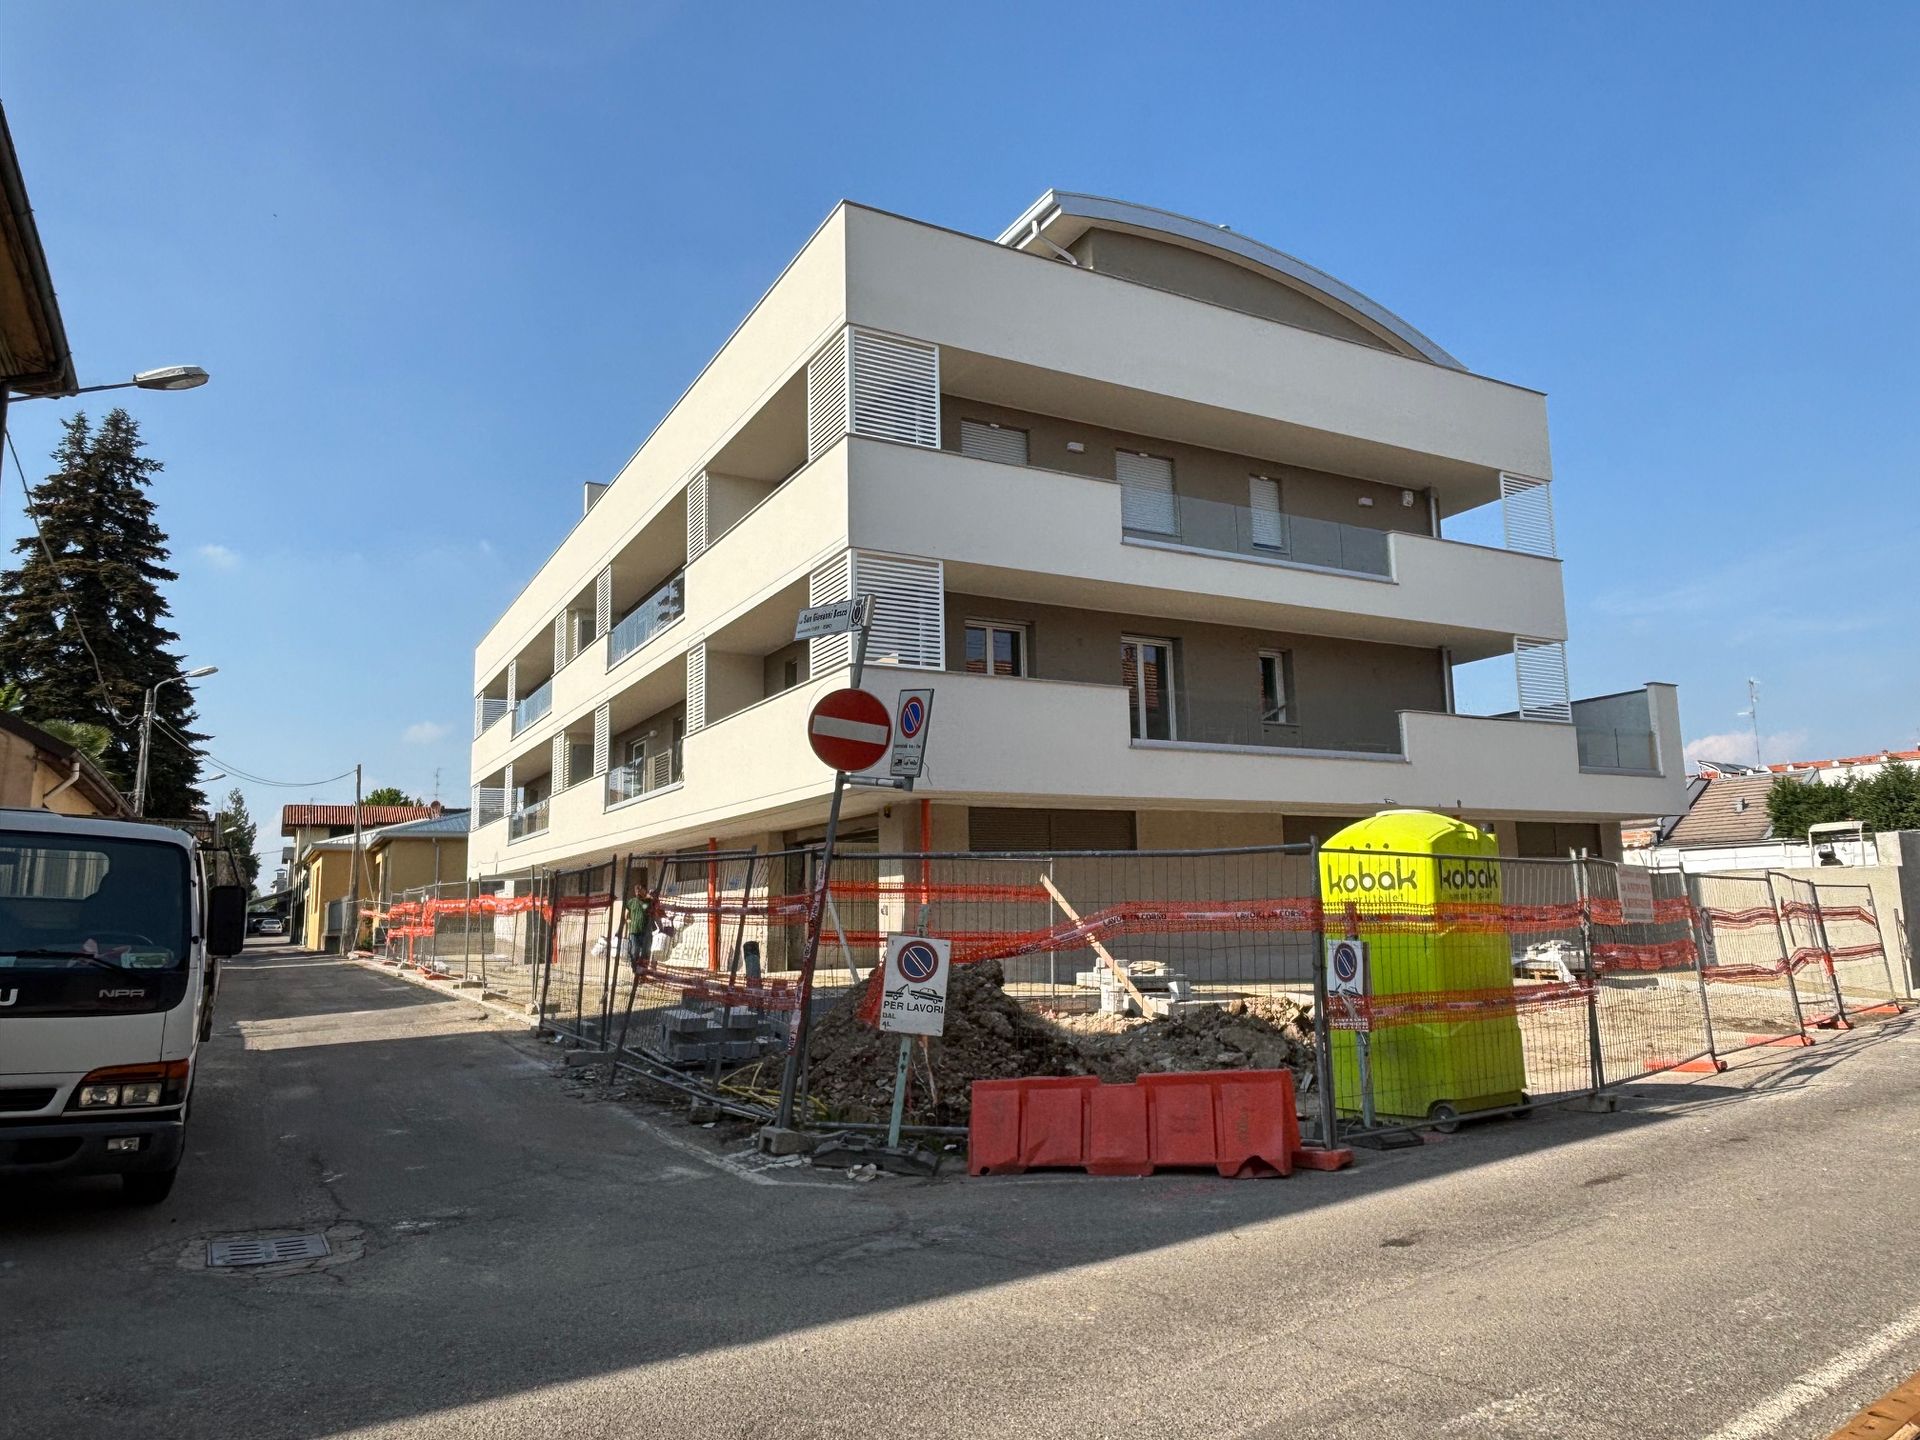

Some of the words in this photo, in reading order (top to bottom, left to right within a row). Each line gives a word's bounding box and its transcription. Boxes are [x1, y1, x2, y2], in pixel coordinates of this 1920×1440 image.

[1328, 858, 1418, 895] kobak
[1438, 859, 1498, 891] kobak
[99, 989, 145, 998] NPR
[883, 1000, 904, 1010] PER
[906, 1002, 944, 1013] LAVORI
[882, 1012, 896, 1020] DAL
